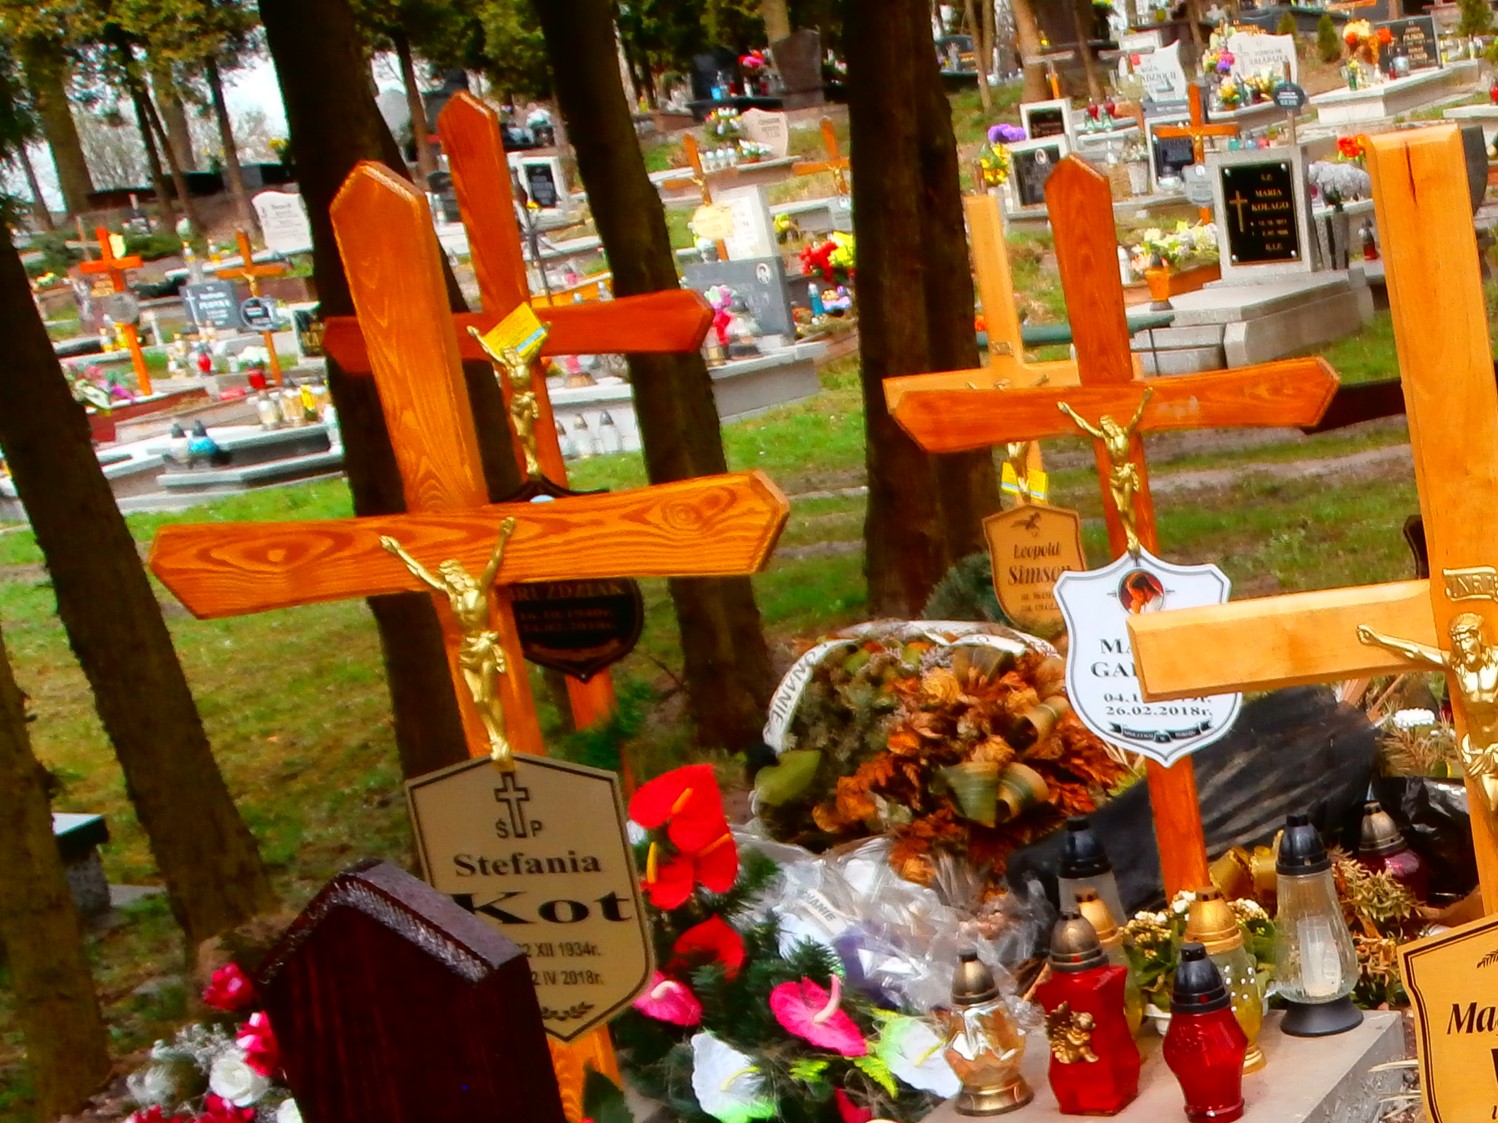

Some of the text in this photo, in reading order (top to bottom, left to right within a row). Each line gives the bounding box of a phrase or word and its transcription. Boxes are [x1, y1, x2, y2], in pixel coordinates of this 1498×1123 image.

[1106, 706, 1212, 716] 26.02.2018r.
[454, 851, 602, 878] Stefania
[451, 891, 633, 924] Kot
[537, 942, 556, 958] XII
[558, 941, 605, 958] 1934r.
[543, 971, 557, 986] IV
[561, 969, 604, 986] 2018r.
